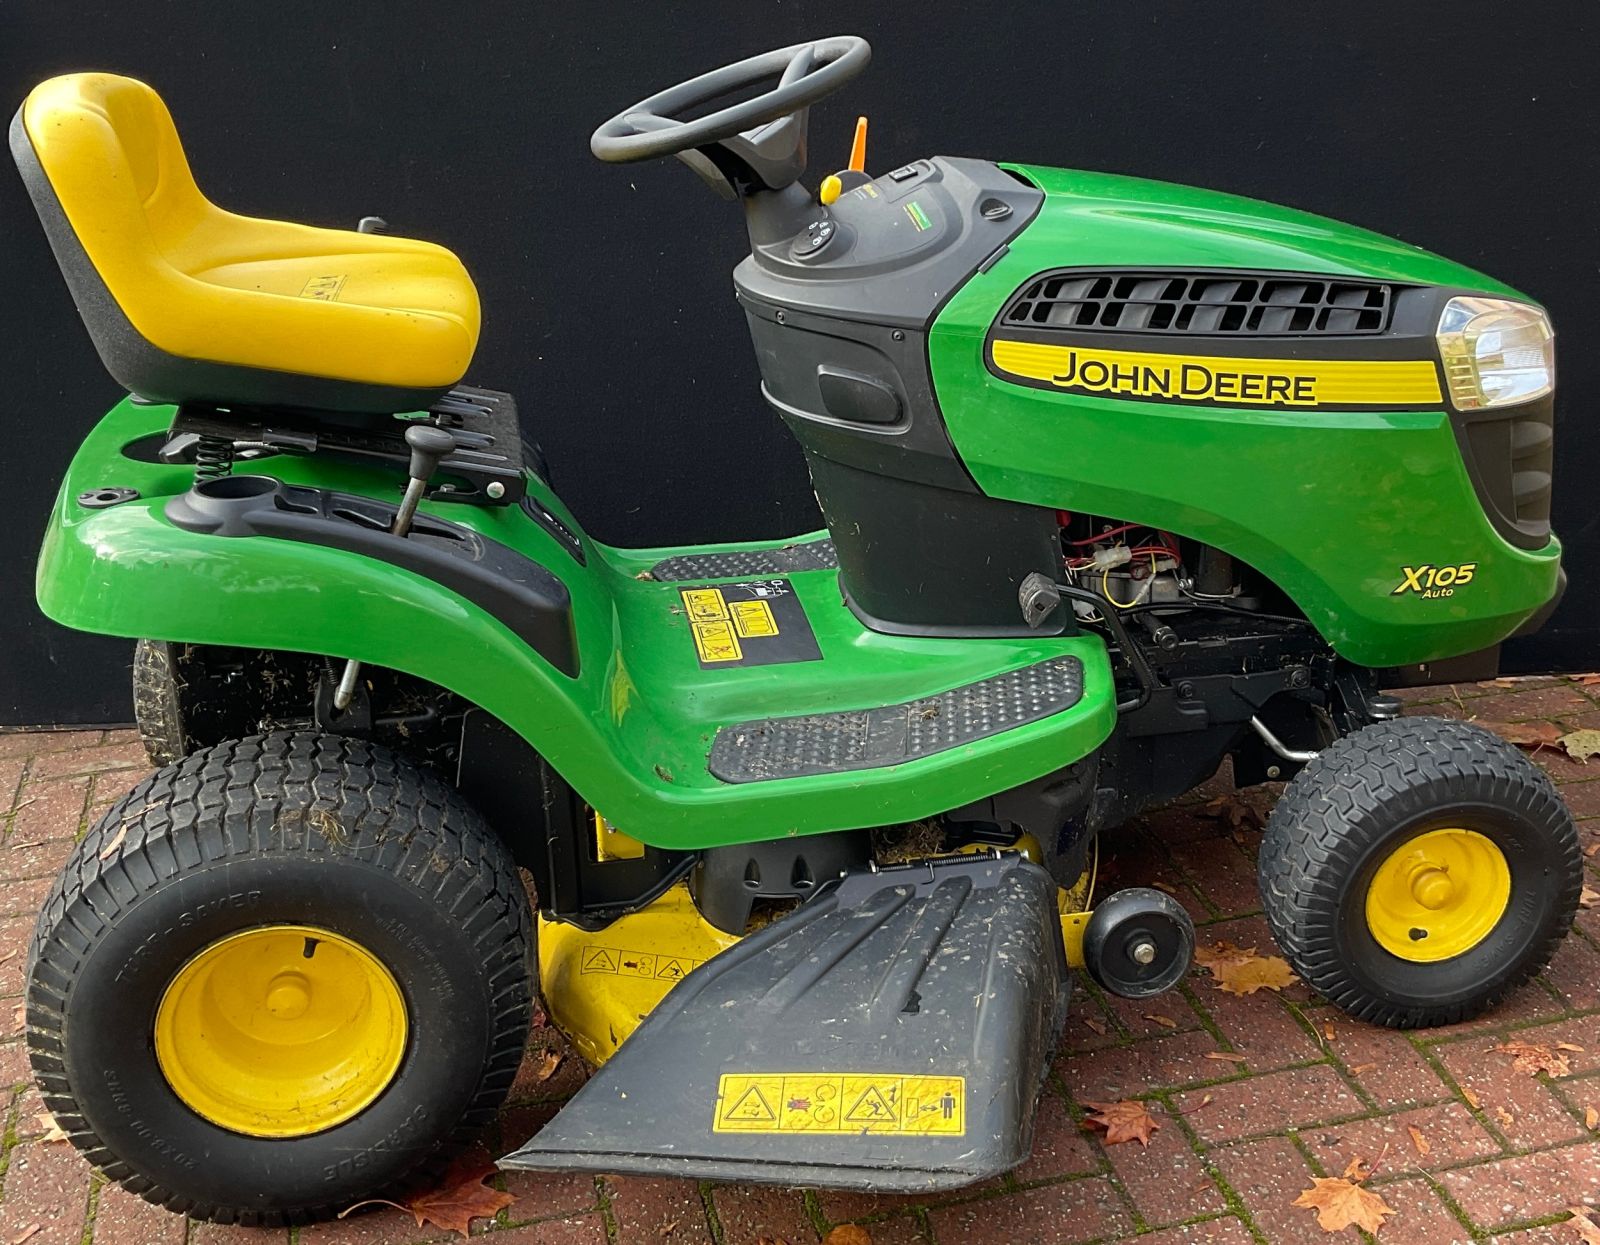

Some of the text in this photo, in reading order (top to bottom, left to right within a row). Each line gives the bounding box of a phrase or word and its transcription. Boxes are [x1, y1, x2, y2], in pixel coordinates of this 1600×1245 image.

[1053, 352, 1317, 402] JOHN DEERE
[1392, 563, 1477, 594] X105
[1421, 587, 1454, 599] Auto
